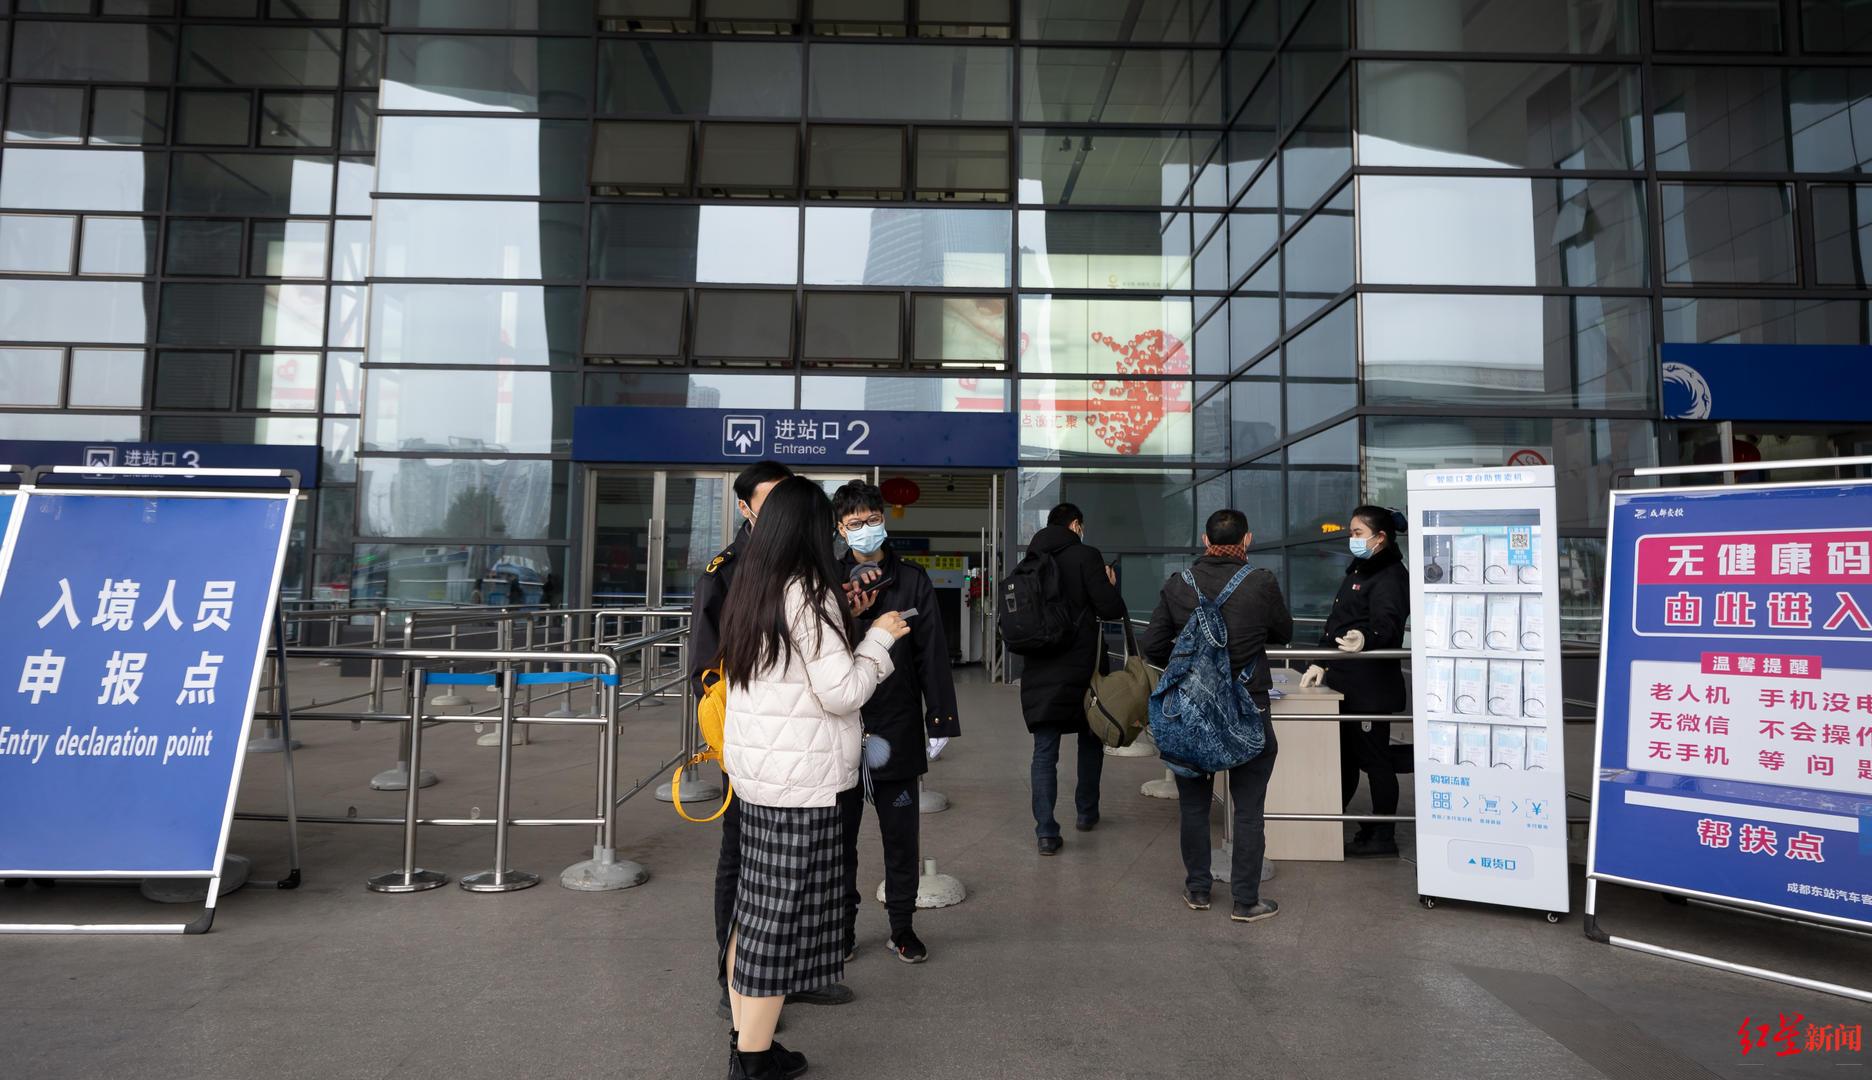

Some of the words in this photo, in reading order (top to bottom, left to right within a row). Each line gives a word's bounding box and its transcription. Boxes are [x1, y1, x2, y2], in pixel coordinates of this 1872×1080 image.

[774, 443, 826, 455] Entrance
[775, 419, 839, 440] 进站口
[846, 420, 870, 455] 2
[124, 449, 177, 467] 进站口
[182, 450, 200, 478] 3
[1668, 541, 1870, 576] 无健康码
[37, 577, 236, 632] 入境人员
[1664, 591, 1872, 631] 由此进入
[17, 649, 224, 706] 申报点
[1712, 655, 1809, 675] 温馨提醒
[1650, 682, 1730, 706] 老人机
[1650, 711, 1730, 736] 无微信
[0, 726, 50, 765] Entry
[55, 726, 159, 757] declaration
[163, 729, 214, 765] point
[1648, 740, 1730, 766] 无手机
[1697, 818, 1825, 863] 帮扶点
[1481, 857, 1516, 871] 取货口
